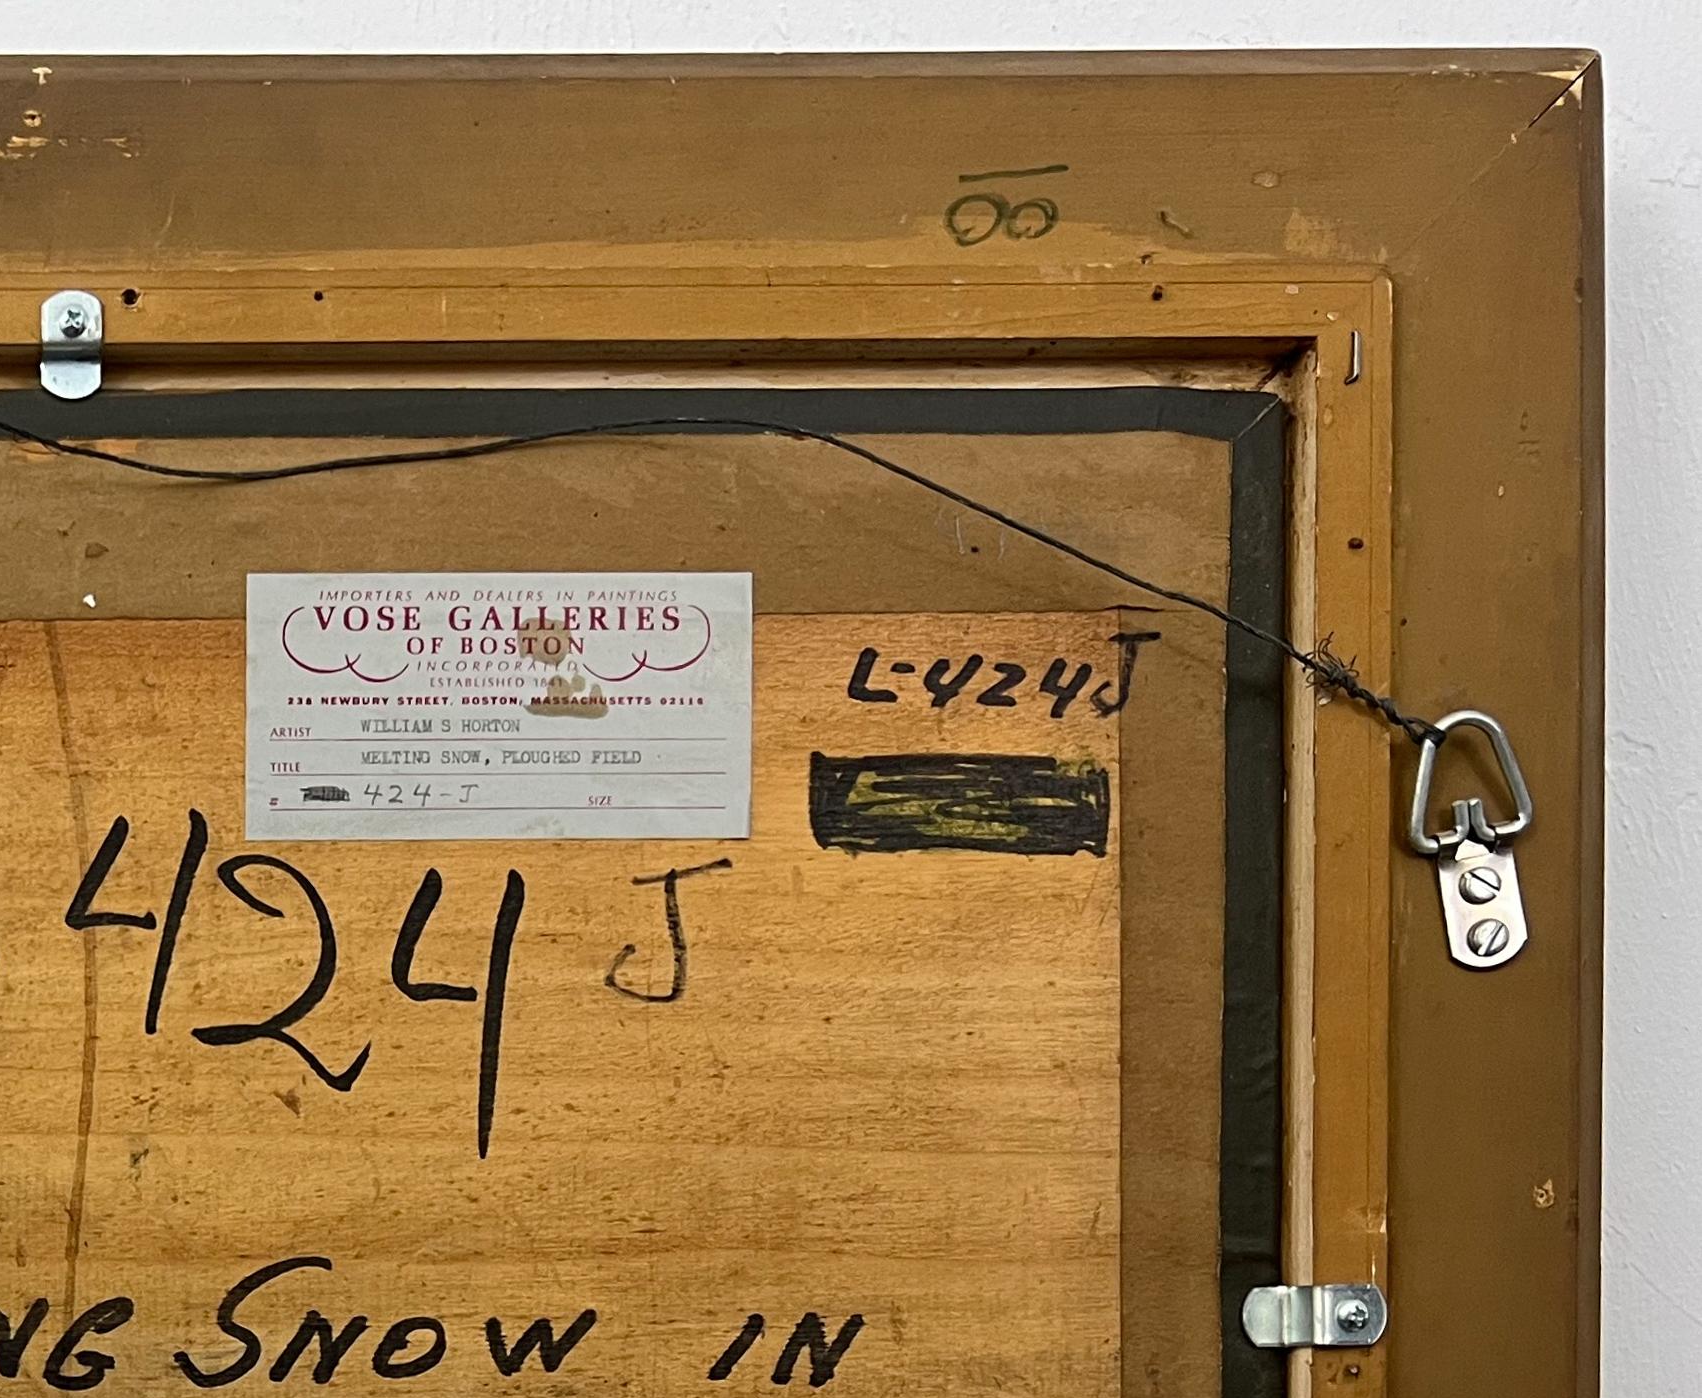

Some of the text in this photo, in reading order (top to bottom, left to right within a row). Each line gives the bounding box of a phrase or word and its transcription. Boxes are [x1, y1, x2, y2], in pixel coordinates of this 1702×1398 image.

[318, 589, 678, 601] IMPORTERS AND DEALERS IN PAINTINGS
[312, 605, 681, 632] VOSE GALLERIES
[406, 636, 586, 656] OF BOSTON
[416, 660, 579, 673] INCORPORATED
[429, 676, 526, 689] ESTABLISHED
[287, 696, 313, 706] 238
[320, 696, 390, 706] NEWBURY
[397, 696, 454, 707] STREET,
[461, 696, 523, 707] BOSTON,
[530, 696, 652, 706] MASSACHUSETTS
[269, 718, 521, 738] ARTIST WILLIAM S HORTON
[269, 750, 642, 773] TITLE MELTING SNOW, PLOUGHED FIELD
[587, 795, 613, 806] SIZE
[170, 1256, 598, 1388] SNOW
[706, 1311, 866, 1388] IN
